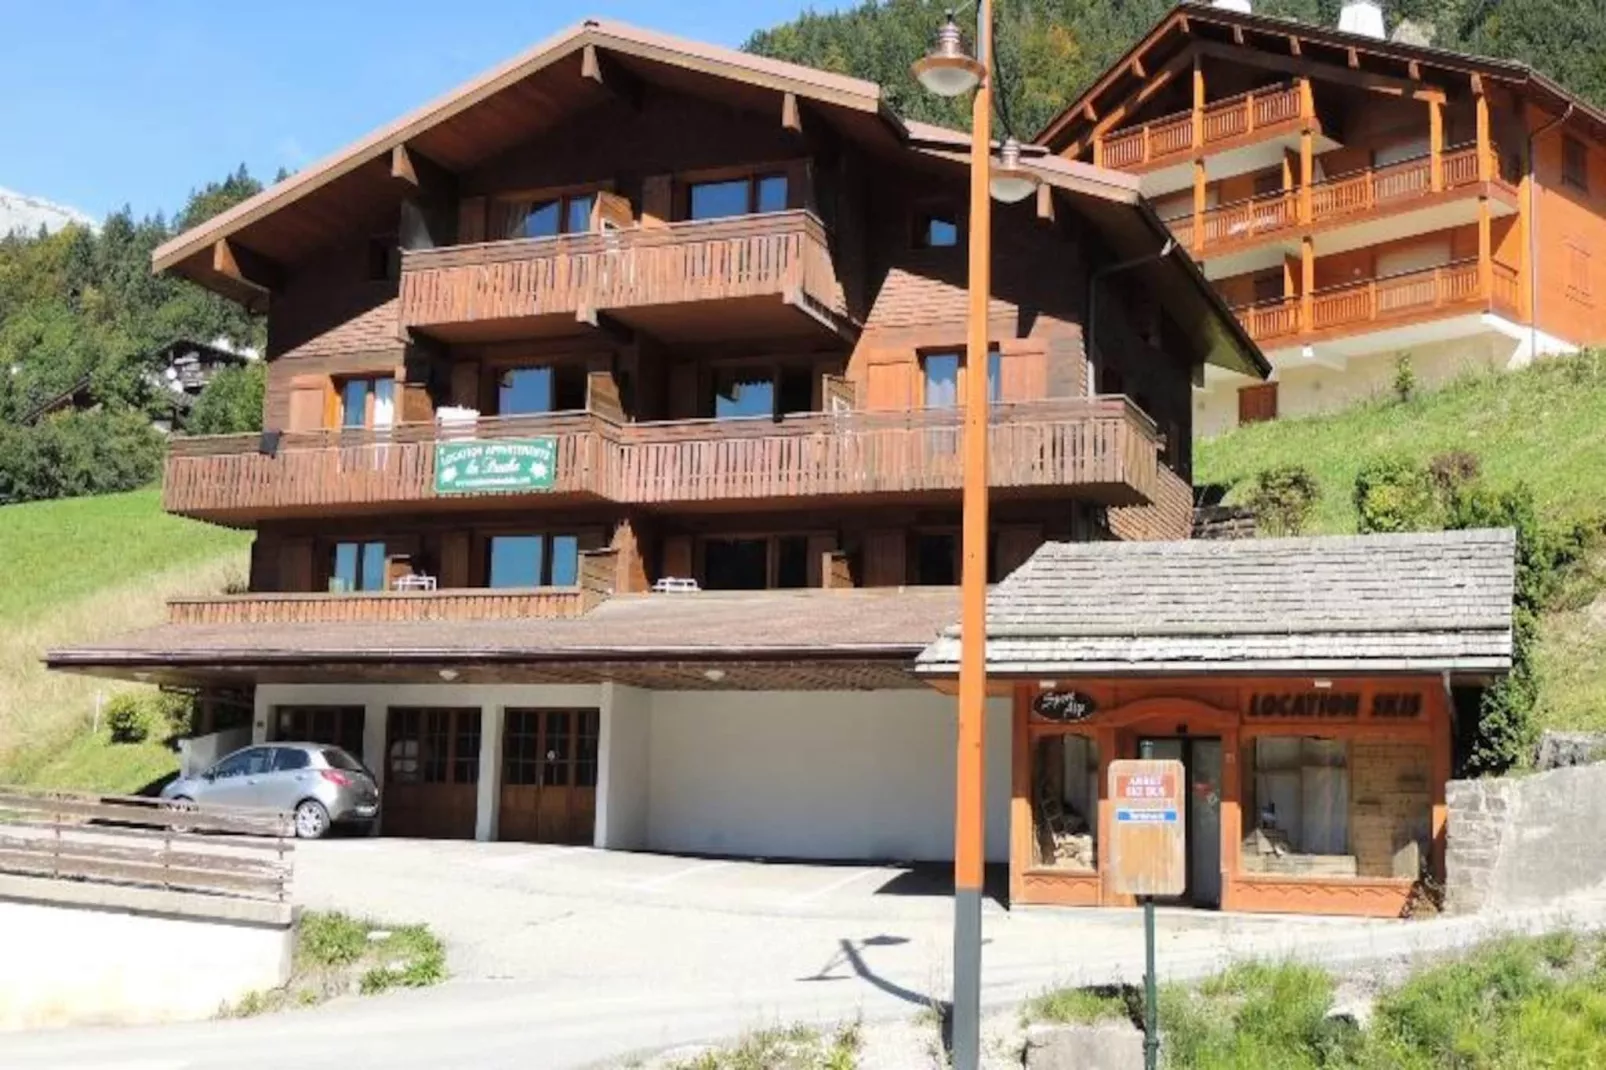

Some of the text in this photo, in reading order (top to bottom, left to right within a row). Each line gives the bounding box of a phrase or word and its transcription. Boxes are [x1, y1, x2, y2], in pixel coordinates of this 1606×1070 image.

[440, 447, 483, 466] LOCATION
[1250, 693, 1423, 717] LOCATION SKIS
